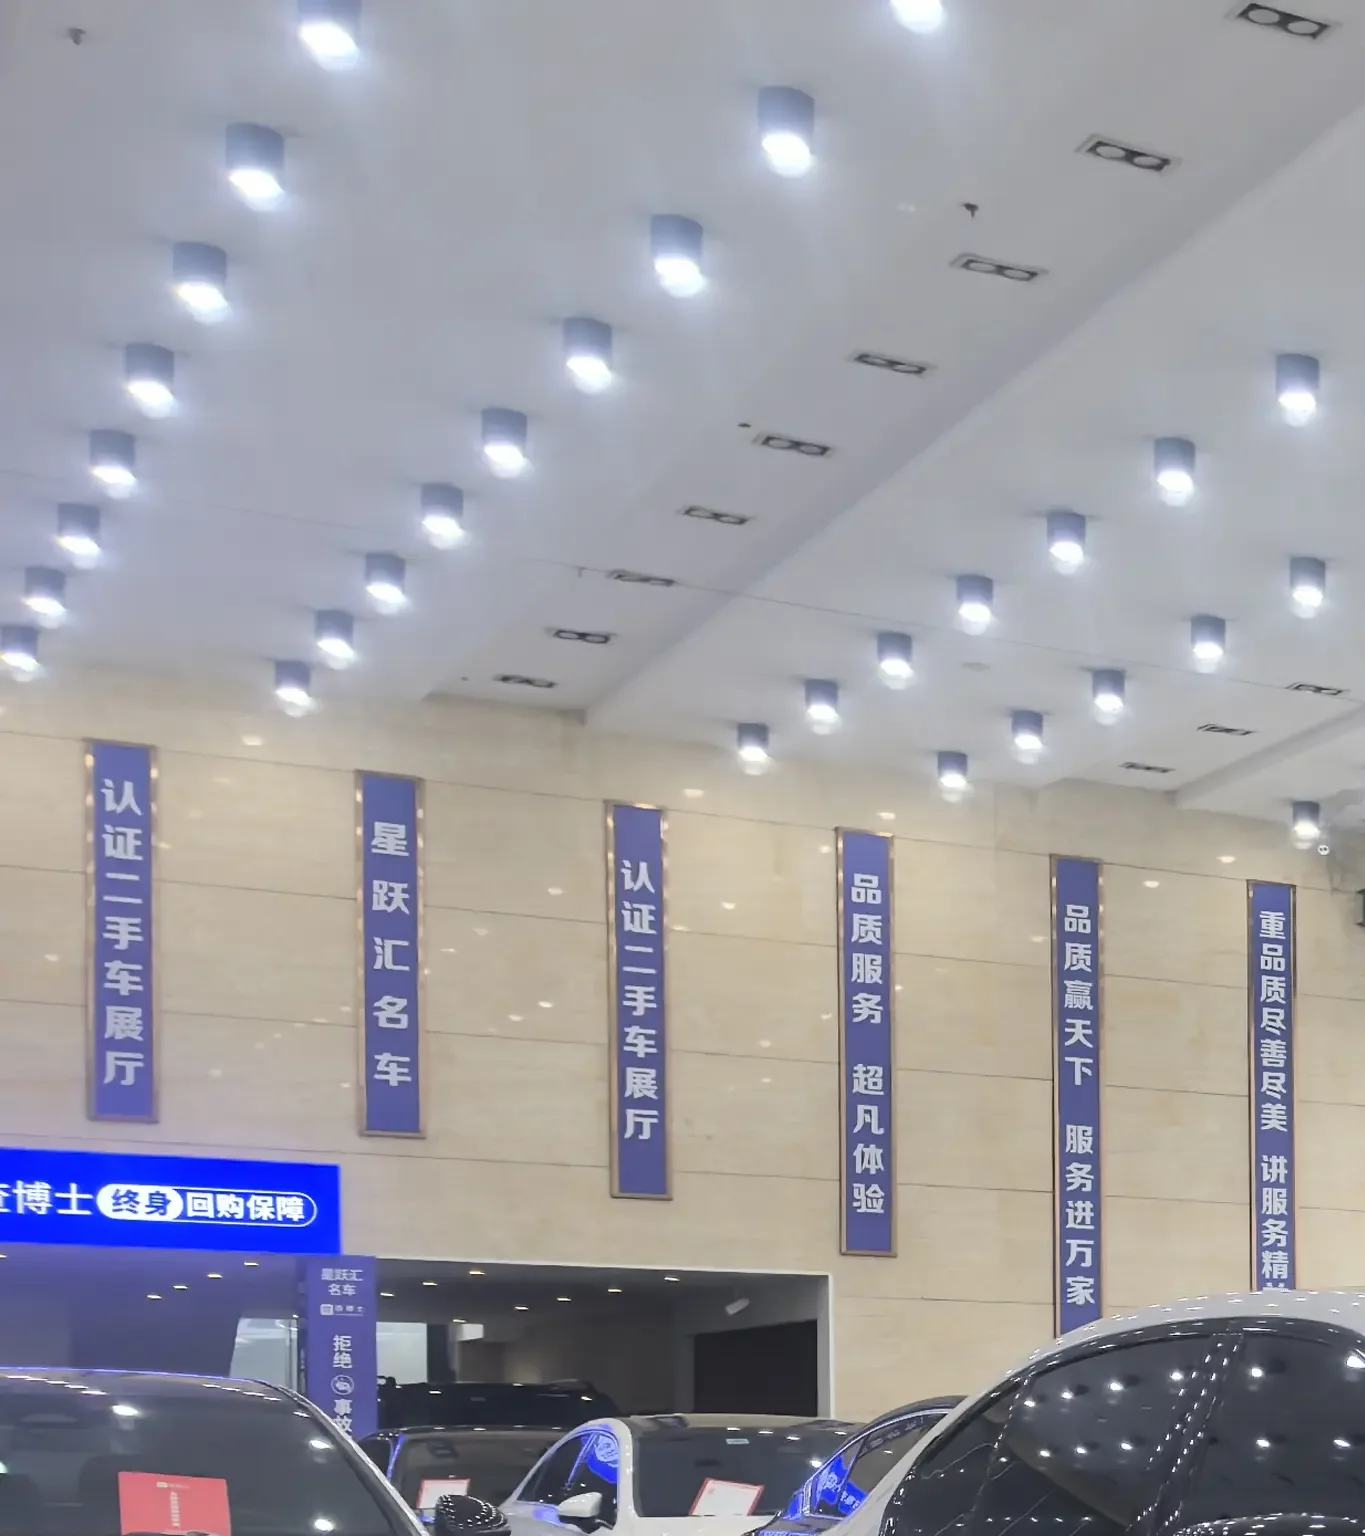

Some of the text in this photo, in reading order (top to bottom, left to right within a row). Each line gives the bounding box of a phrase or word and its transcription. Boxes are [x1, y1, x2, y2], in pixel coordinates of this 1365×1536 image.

[102, 779, 145, 1086] 认证二手车展厅
[371, 822, 412, 1087] 星跃汇名车
[621, 860, 660, 1141] 认证二手车展厅
[851, 874, 885, 1215] 品质服务 超凡体验
[111, 1188, 172, 1216] 终身
[186, 1191, 306, 1222] 回购保障
[1064, 905, 1096, 1306] 品质赢天下 服务进万家
[1259, 911, 1289, 1289] 重品质尽善尽美 讲服务精
[321, 1268, 363, 1282] 星跃汇
[328, 1284, 356, 1296] 名车
[333, 1335, 352, 1369] 拒绝
